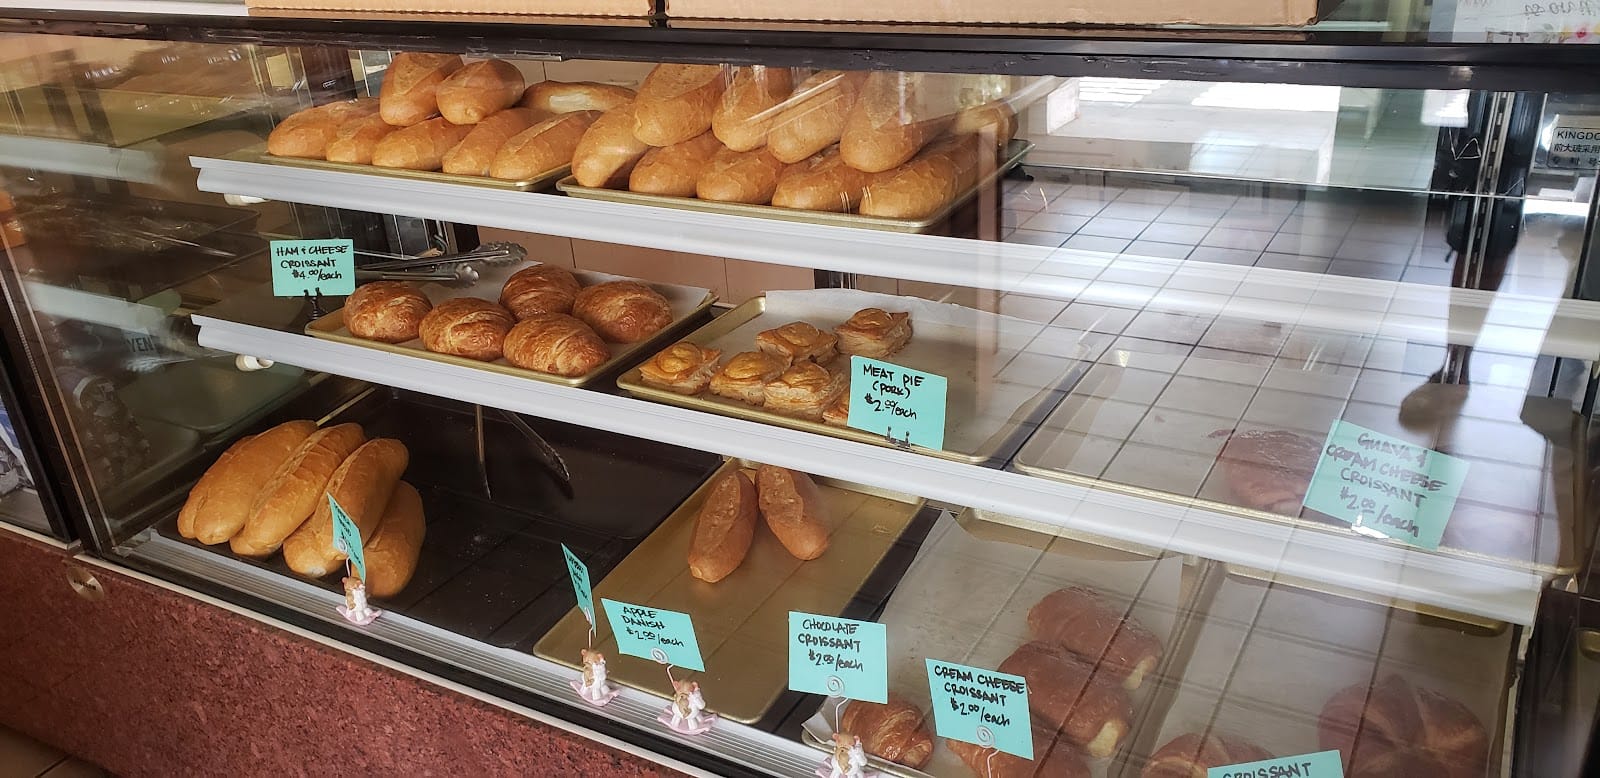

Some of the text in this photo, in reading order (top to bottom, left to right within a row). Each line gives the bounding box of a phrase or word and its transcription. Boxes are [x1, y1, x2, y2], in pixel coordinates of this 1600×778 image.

[276, 246, 299, 256] HAM
[308, 245, 349, 255] CHEESE
[280, 257, 337, 269] CROISSANT
[863, 364, 925, 387] MEAT PIE
[872, 380, 911, 399] (PORK)
[1358, 433, 1411, 462] GUAVA
[1326, 444, 1448, 491] CREAM CHEESE
[1340, 467, 1427, 508] CROISSANT
[621, 614, 666, 629] DANISH
[623, 606, 658, 619] APPLE
[802, 618, 860, 635] CHOCOLATE
[798, 633, 861, 653] CROISSANT
[934, 665, 1025, 694] CREAM CHEESE
[944, 682, 1007, 706] CROISSANT
